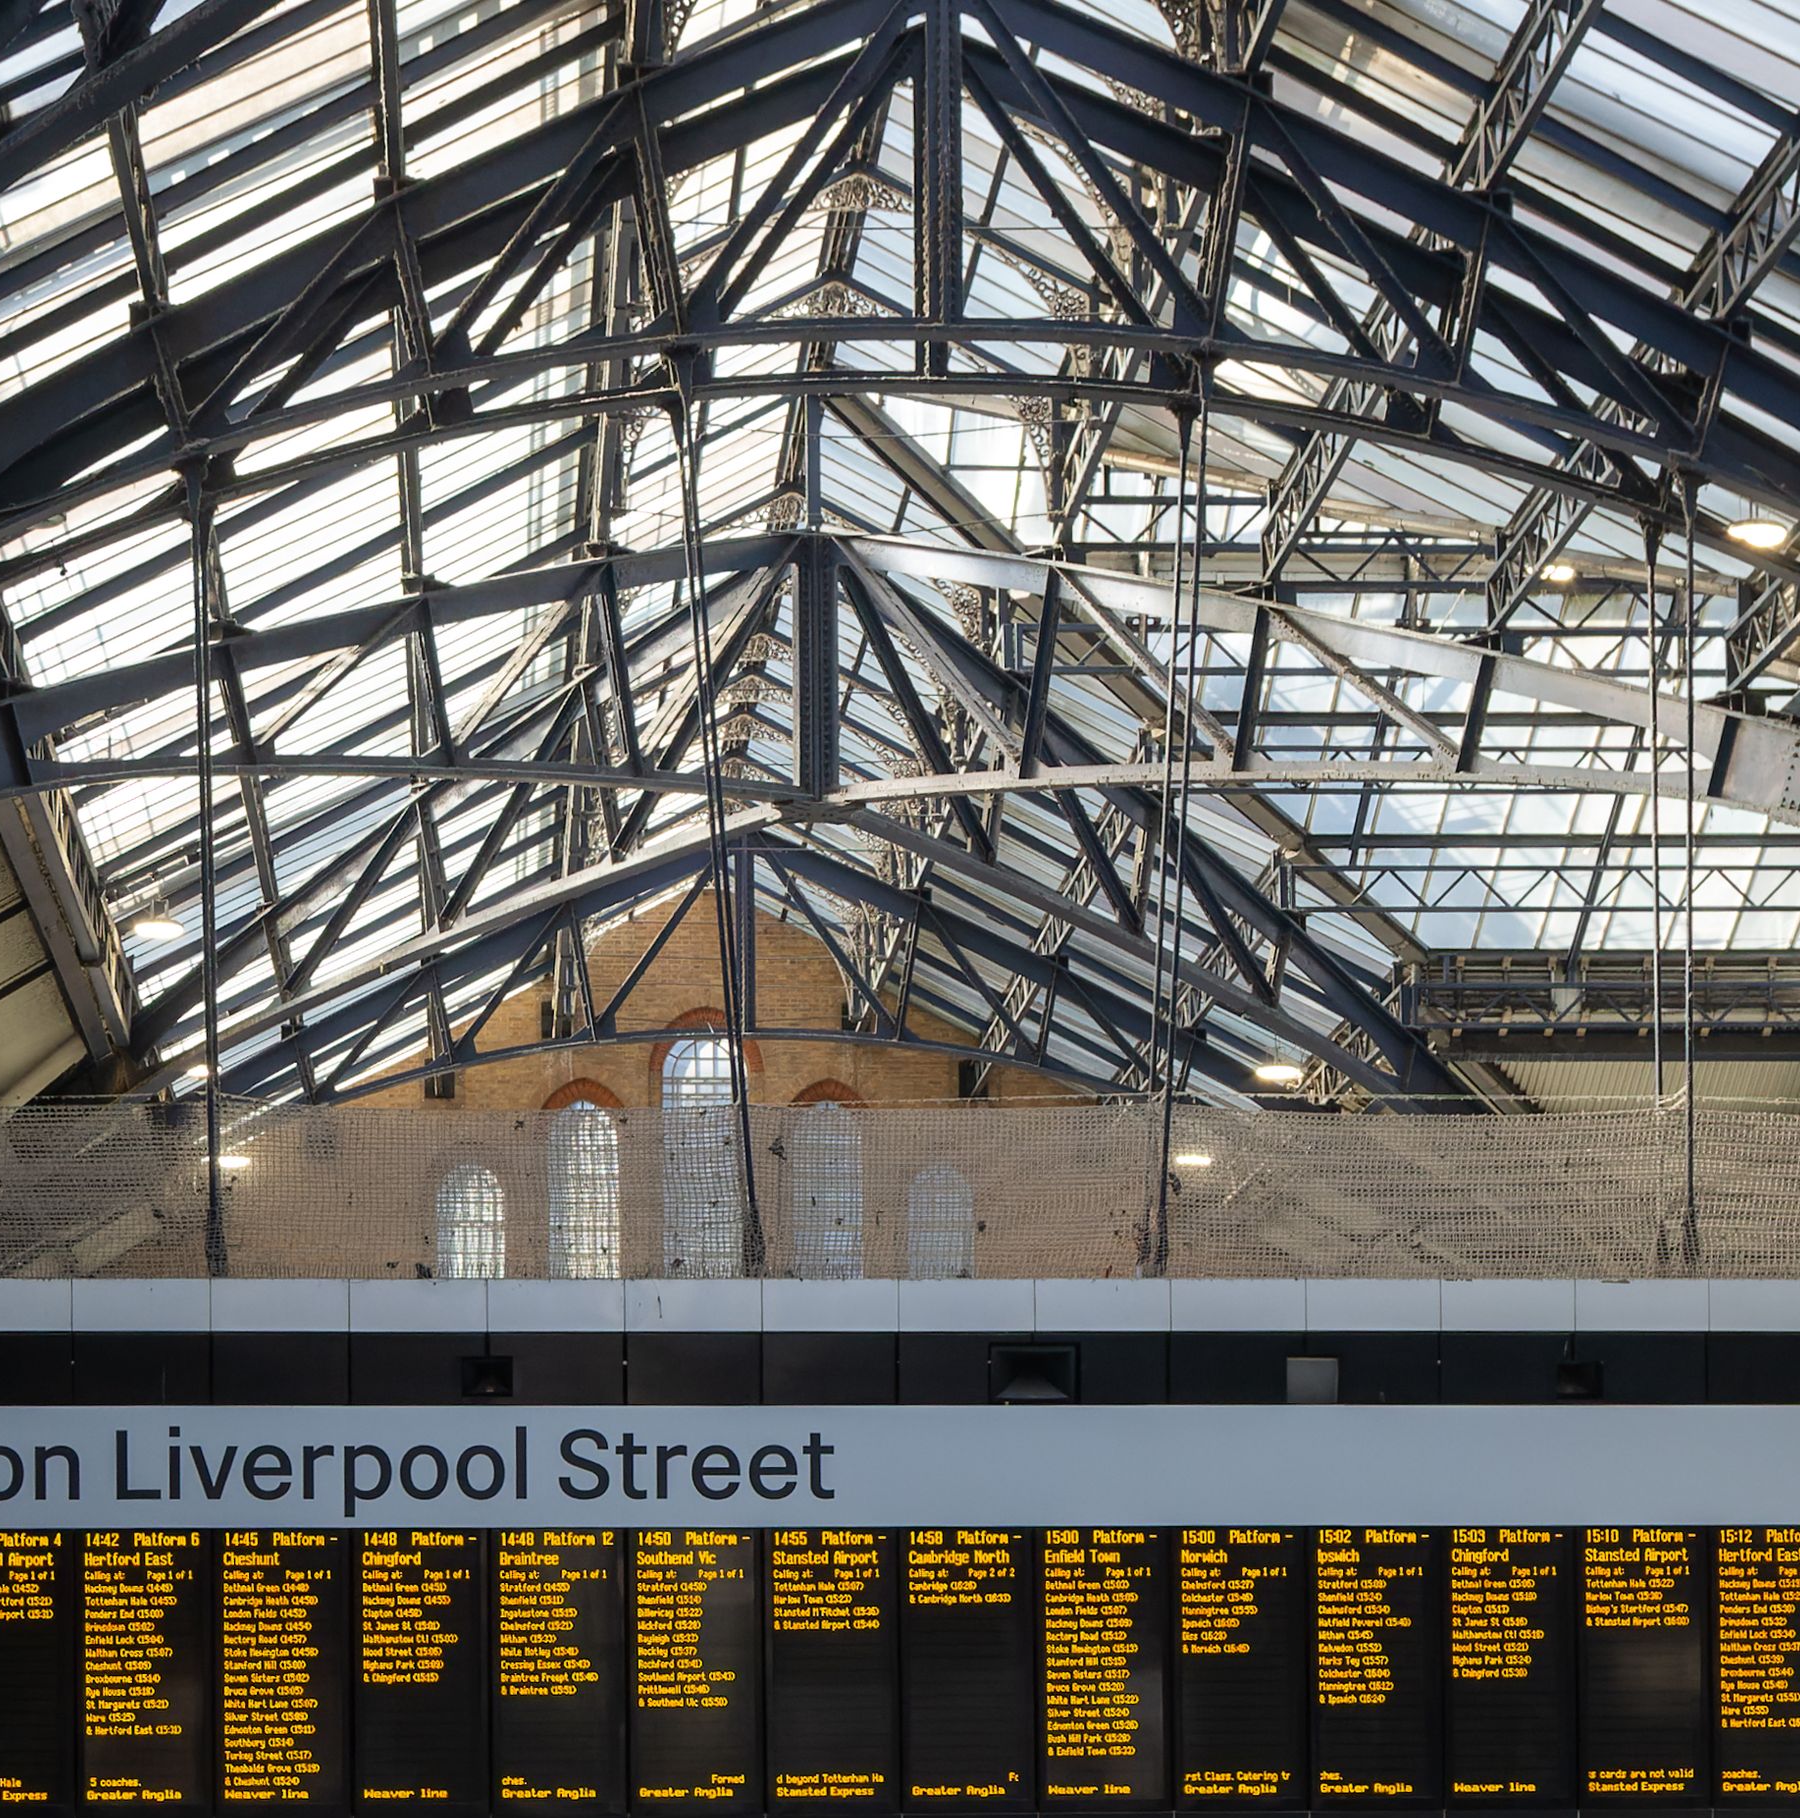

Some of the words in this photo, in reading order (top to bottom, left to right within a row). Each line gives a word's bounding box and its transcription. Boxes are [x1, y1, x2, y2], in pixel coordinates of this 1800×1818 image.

[115, 1427, 528, 1517] Liverpool
[557, 1428, 836, 1501] Street
[54, 1533, 62, 1547] 4
[8, 1552, 54, 1568] Airport
[499, 1552, 559, 1566] Braintree
[1045, 1550, 1085, 1564] Enfield
[1089, 1550, 1120, 1564] Town
